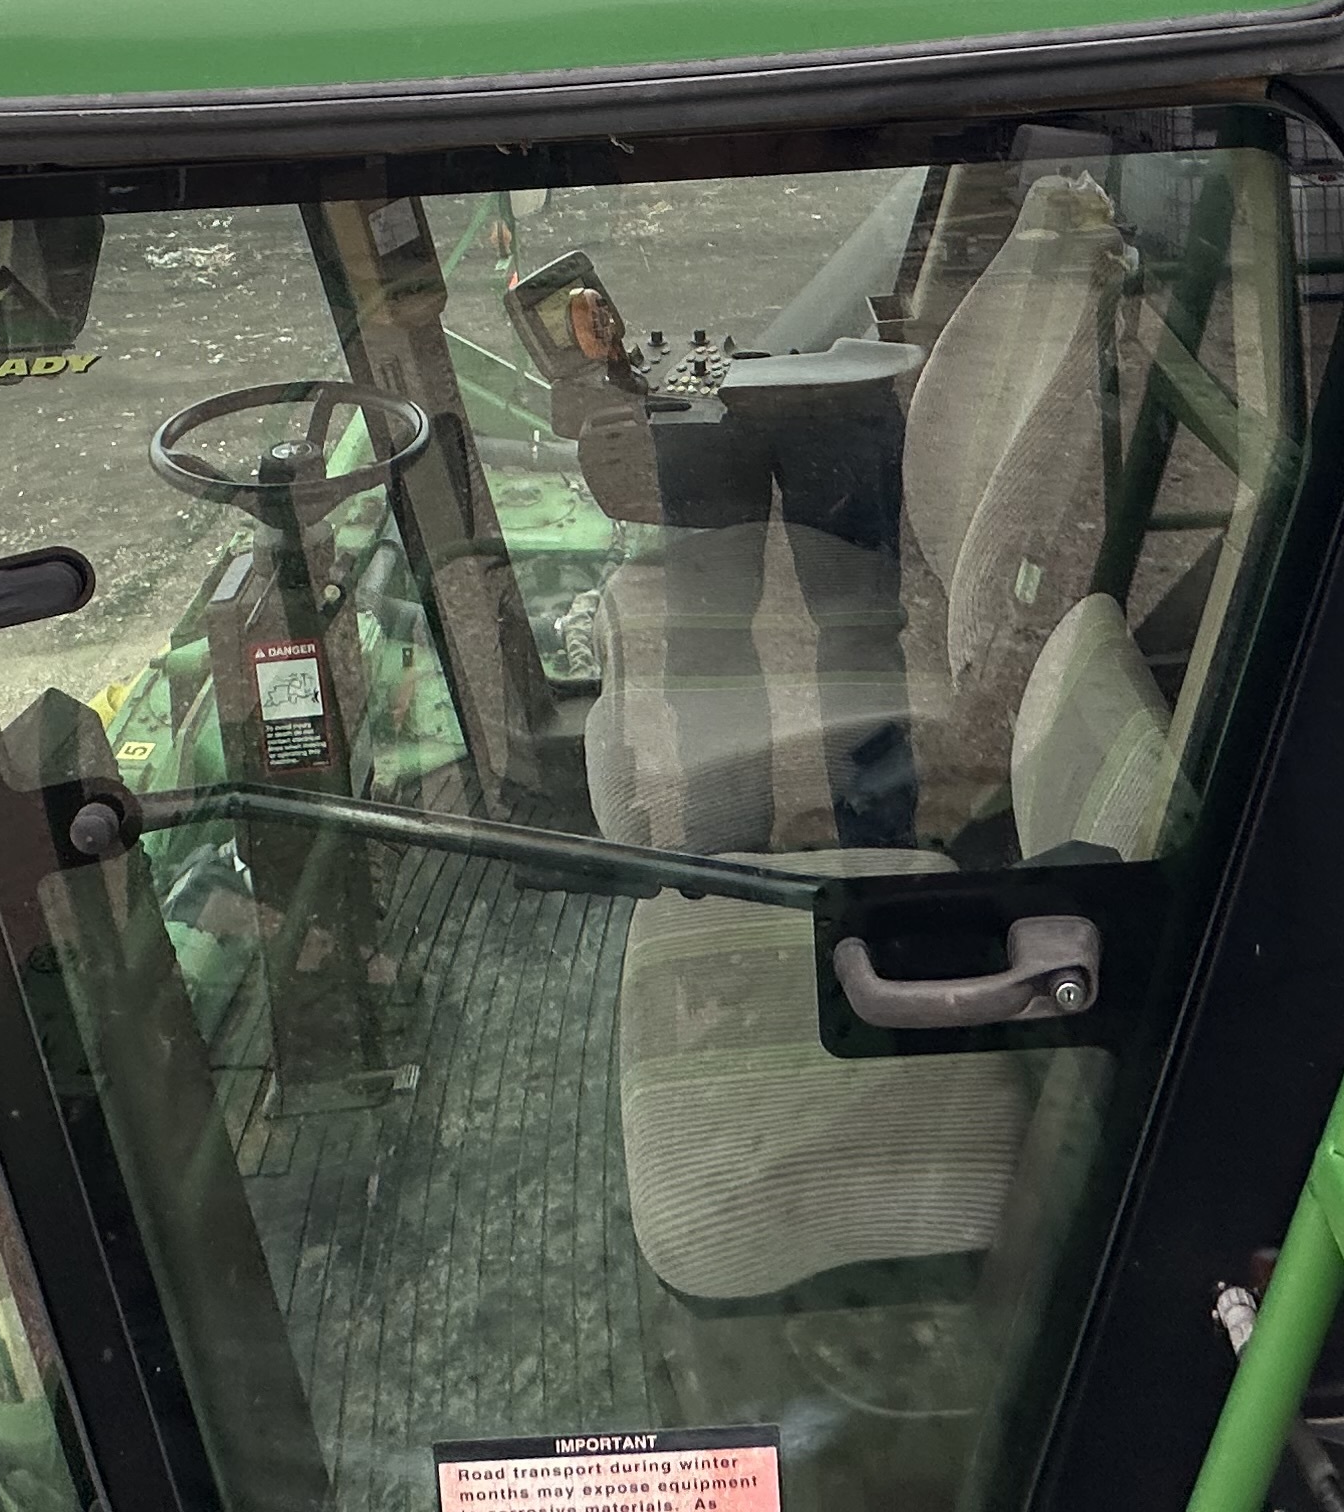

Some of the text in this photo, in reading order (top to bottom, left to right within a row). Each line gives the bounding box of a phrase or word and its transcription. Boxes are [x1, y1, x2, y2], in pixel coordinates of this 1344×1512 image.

[268, 644, 316, 657] DANGER
[124, 745, 149, 756] 5
[555, 1434, 658, 1453] IMPORTANT
[458, 1456, 739, 1481] Road transport during winter
[459, 1475, 758, 1502] months may expose equipment
[694, 1497, 717, 1510] As
